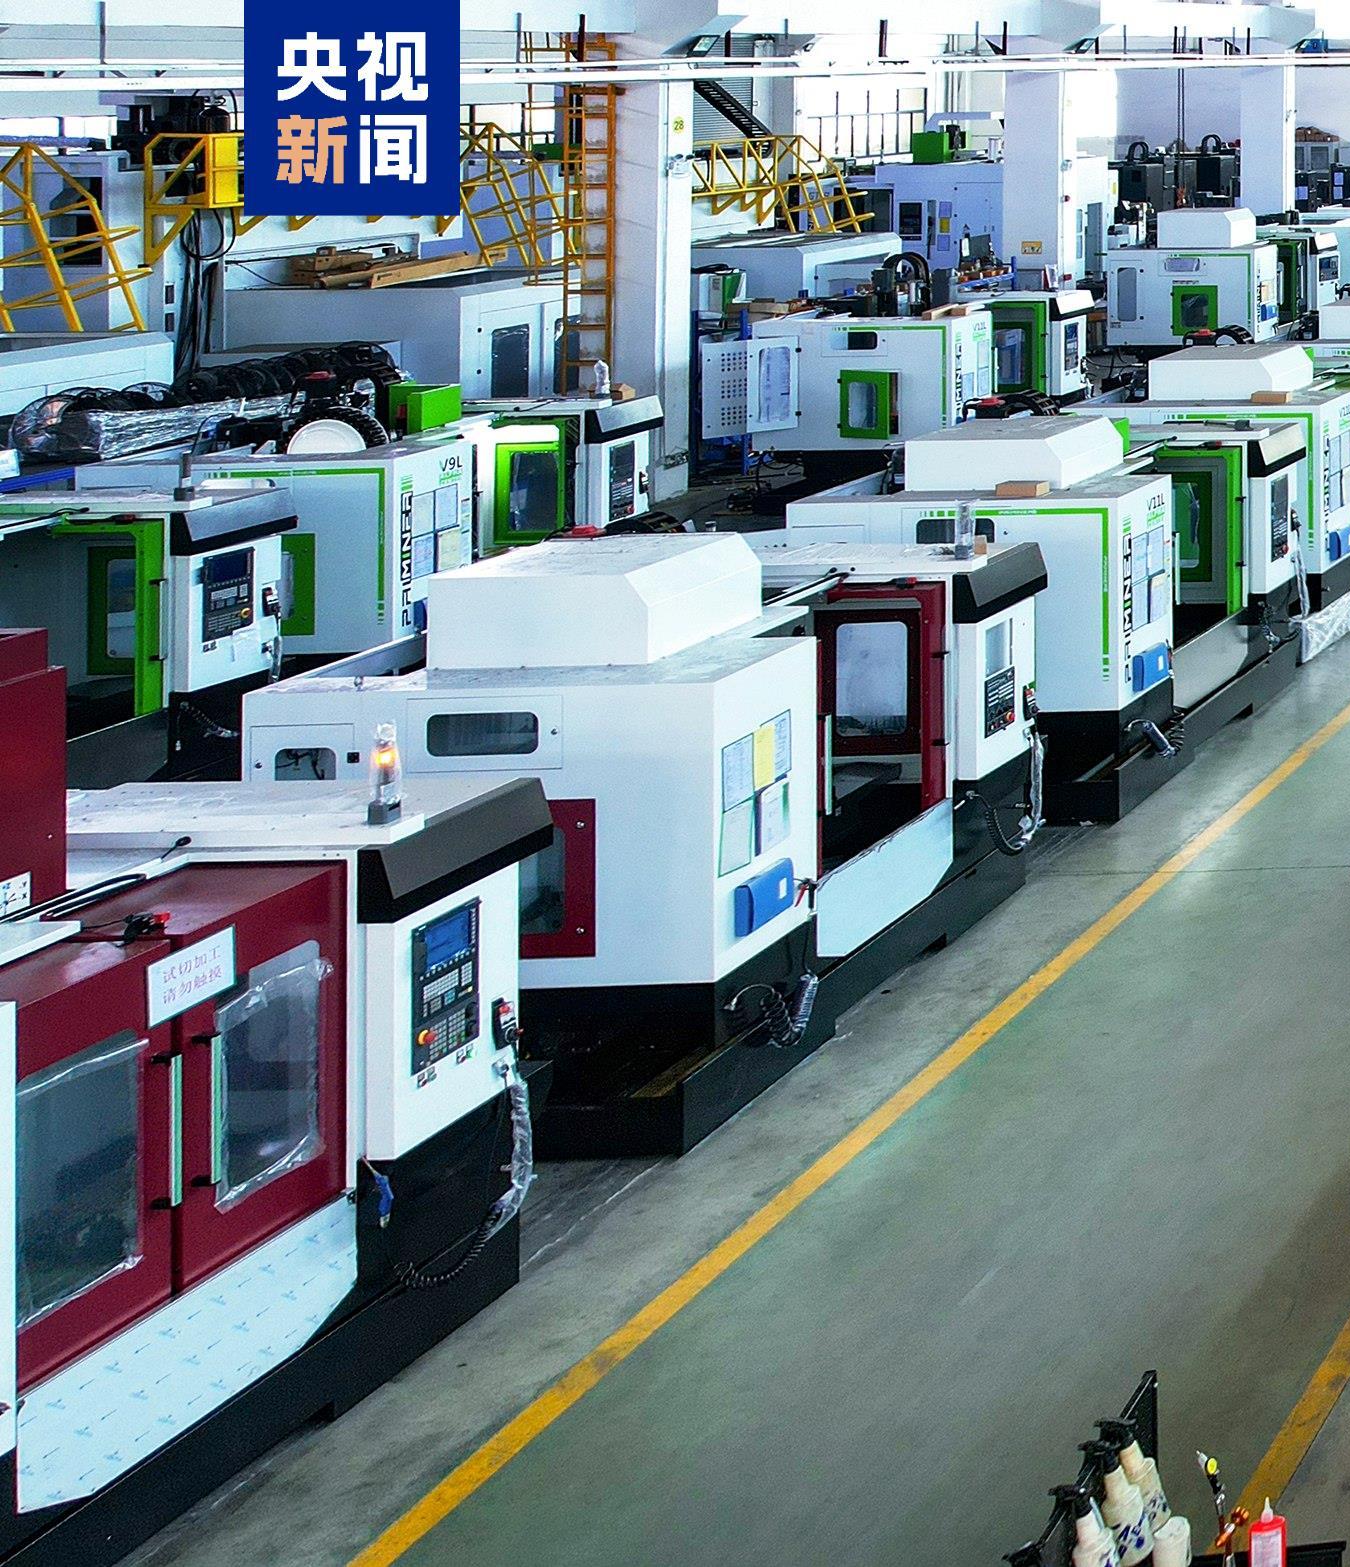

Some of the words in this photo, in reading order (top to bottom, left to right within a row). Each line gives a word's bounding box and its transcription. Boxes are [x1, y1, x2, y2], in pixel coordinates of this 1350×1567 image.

[674, 120, 684, 130] 28
[439, 456, 463, 471] V9L
[163, 945, 221, 983] 试切加工
